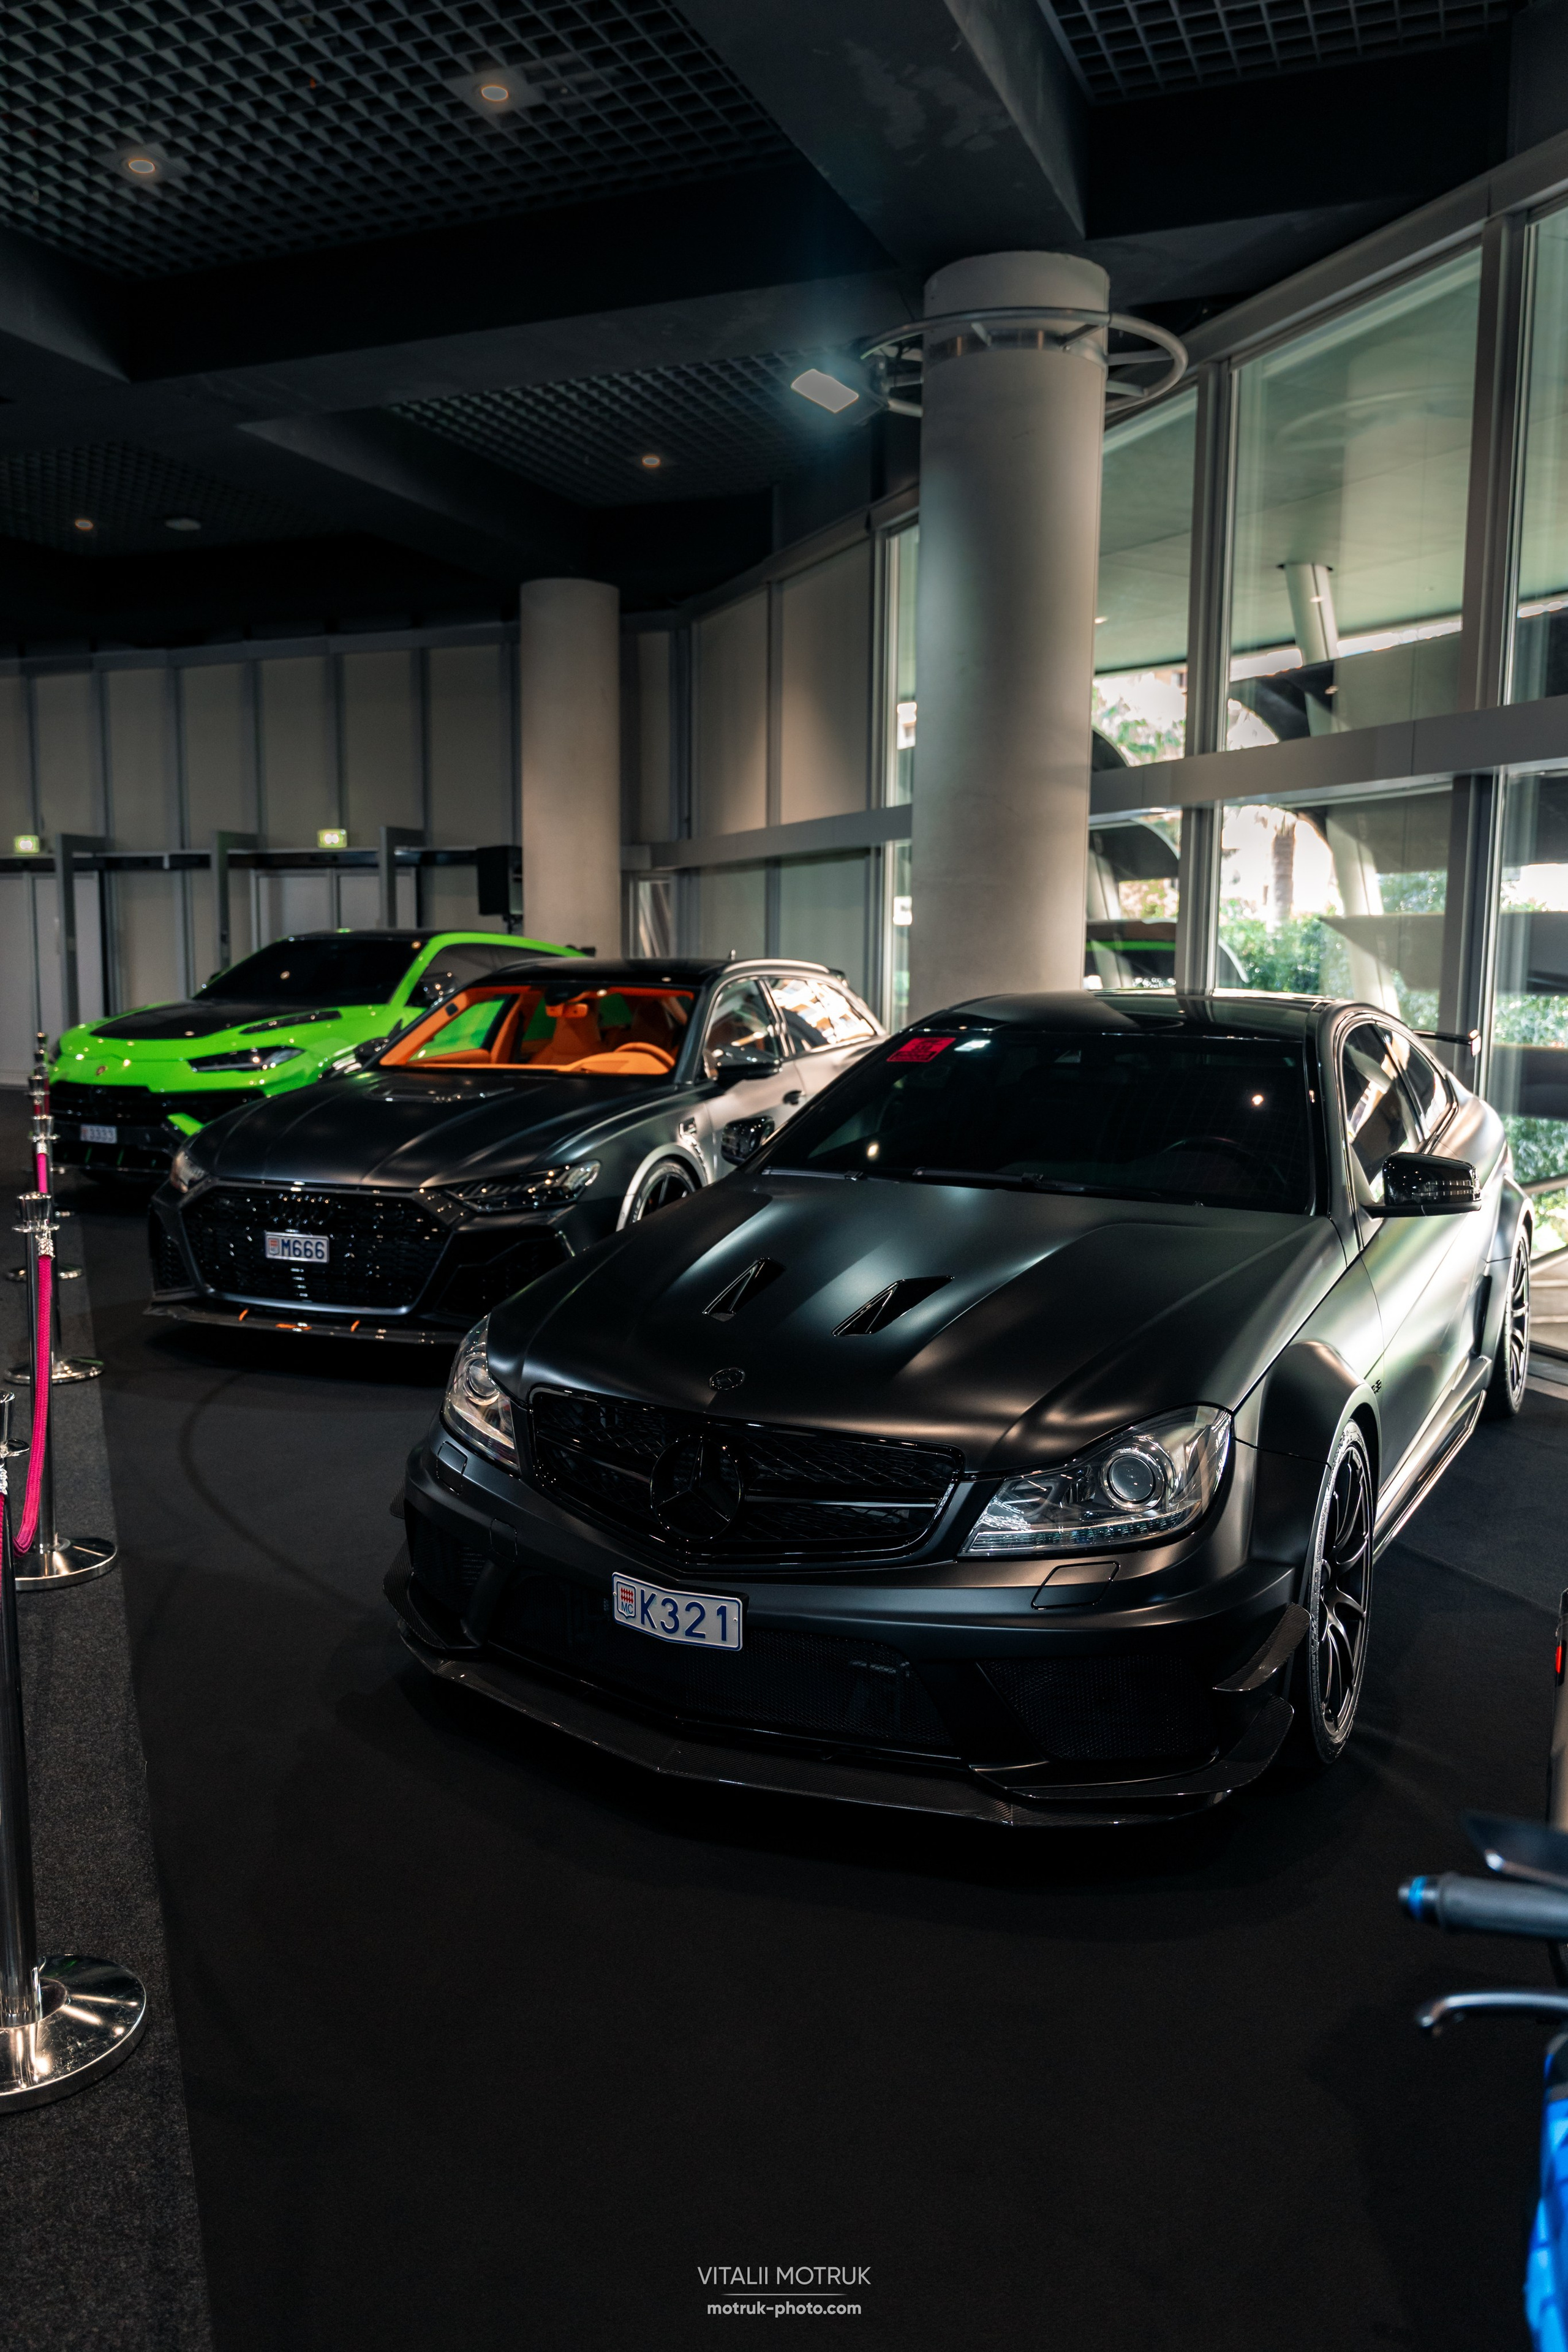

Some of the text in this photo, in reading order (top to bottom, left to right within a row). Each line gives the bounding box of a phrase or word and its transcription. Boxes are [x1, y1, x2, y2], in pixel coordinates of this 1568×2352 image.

[281, 1239, 325, 1259] M666
[621, 1601, 633, 1614] MC
[641, 1588, 727, 1642] K321
